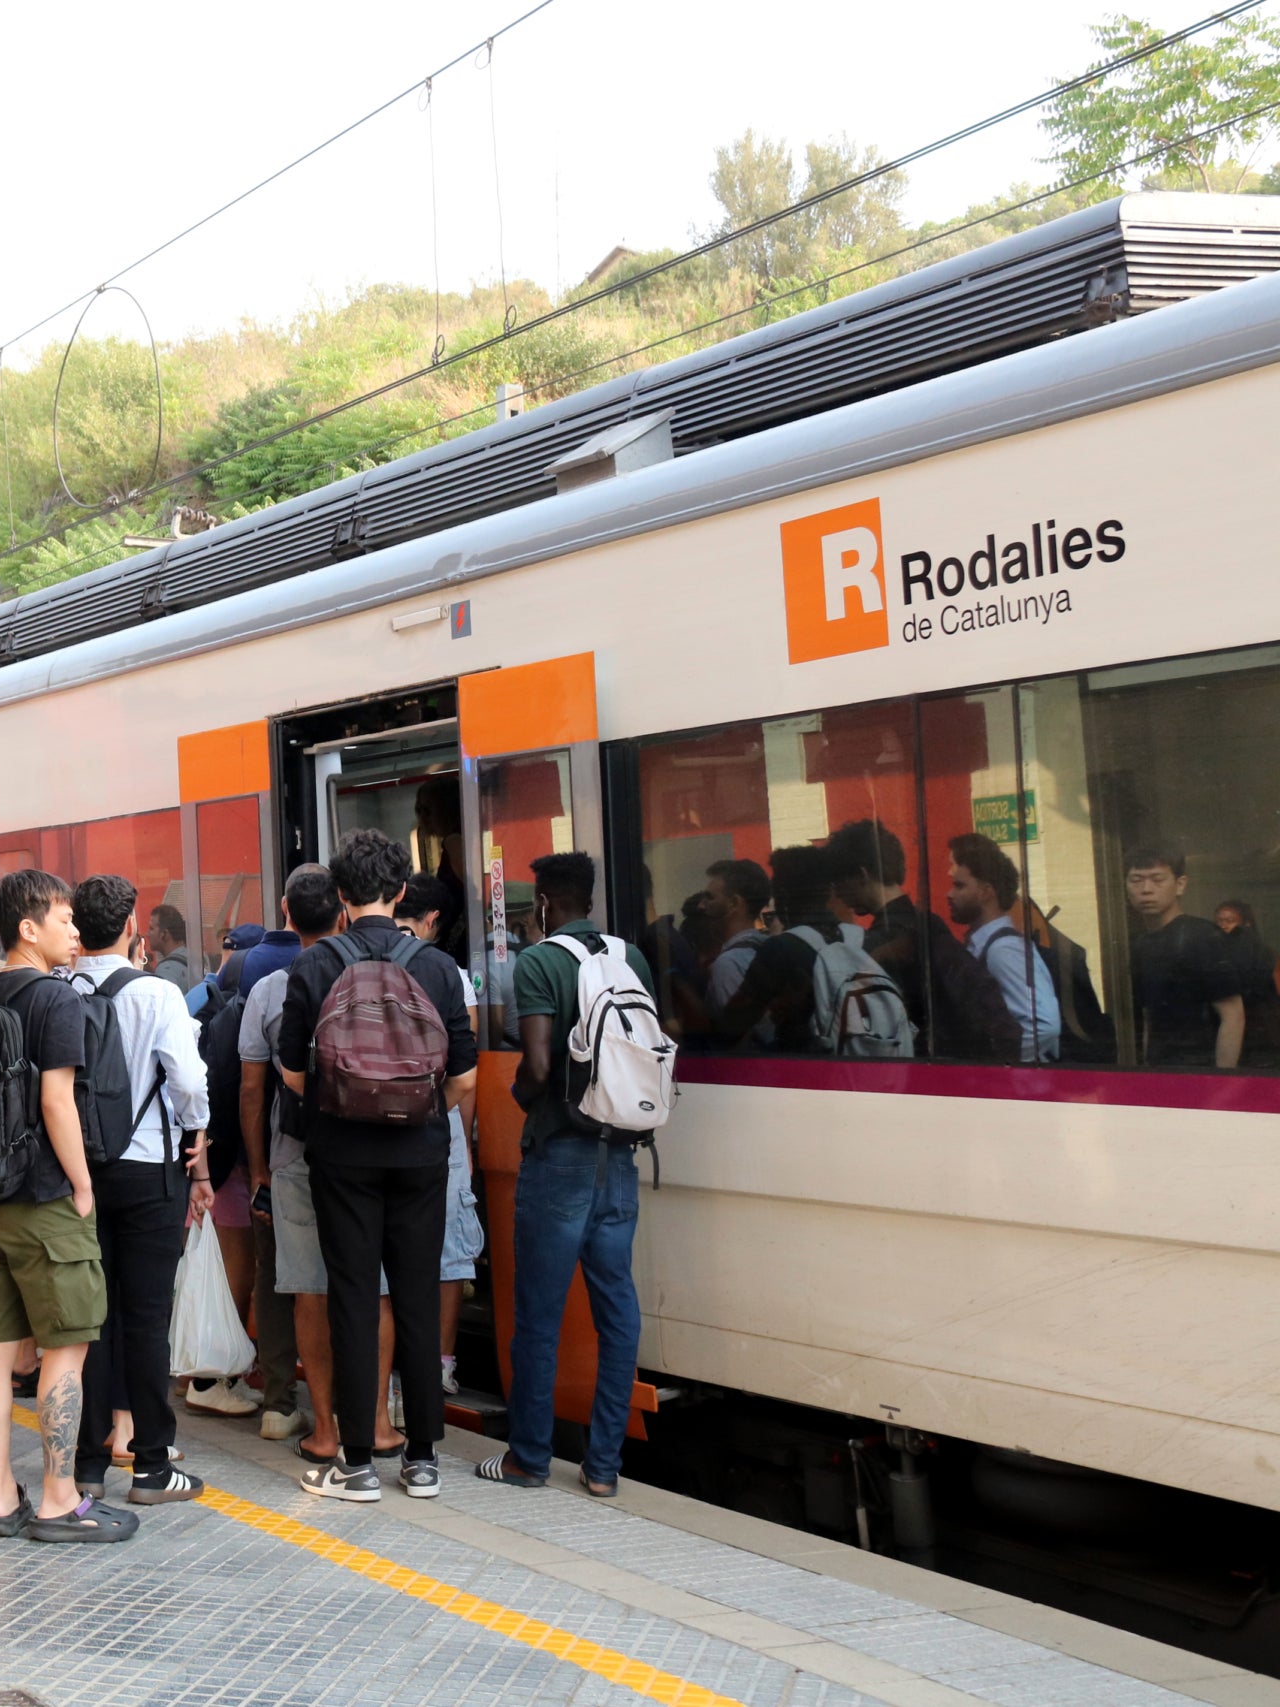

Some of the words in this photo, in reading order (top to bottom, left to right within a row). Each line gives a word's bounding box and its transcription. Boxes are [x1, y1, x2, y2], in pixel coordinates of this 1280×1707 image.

[821, 526, 883, 621] R
[901, 518, 1126, 605] Rodalies
[902, 613, 932, 643] de
[940, 589, 1072, 635] Catalunya
